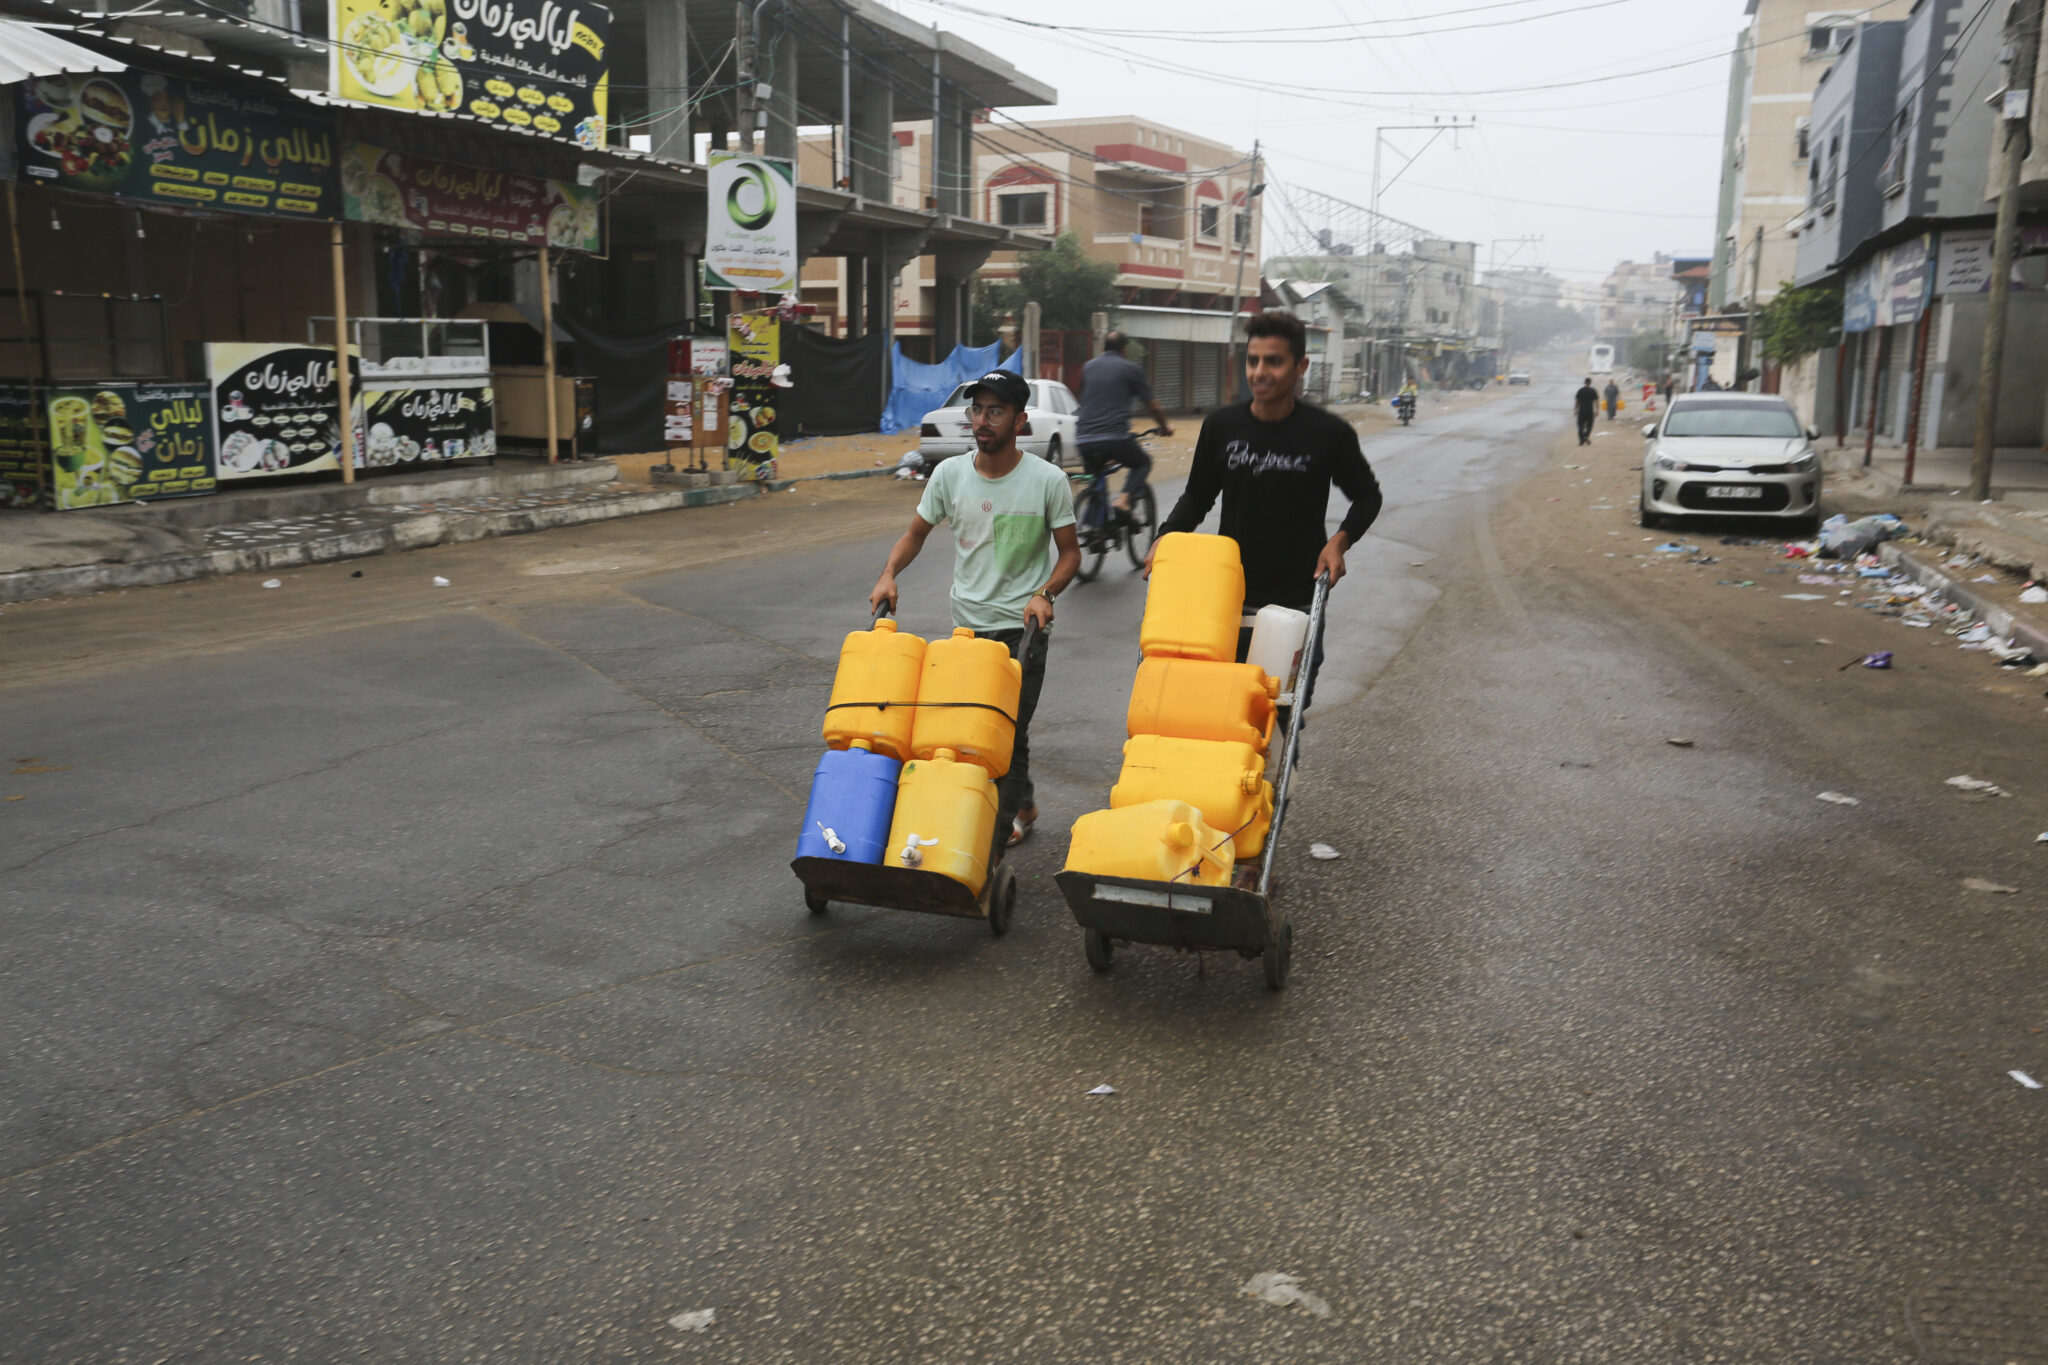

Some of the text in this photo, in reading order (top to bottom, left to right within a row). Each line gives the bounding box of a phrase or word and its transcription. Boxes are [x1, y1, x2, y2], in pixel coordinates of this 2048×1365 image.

[454, 0, 514, 37] زمان
[510, 1, 580, 55] ليالي
[178, 112, 253, 167] زمان
[260, 127, 331, 175] ليالي
[416, 163, 504, 201] ليالي زمان
[245, 360, 334, 397] ليالي زمان
[150, 399, 203, 435] ليالي
[402, 391, 463, 421] ليالي زمان
[156, 432, 204, 463] زمان
